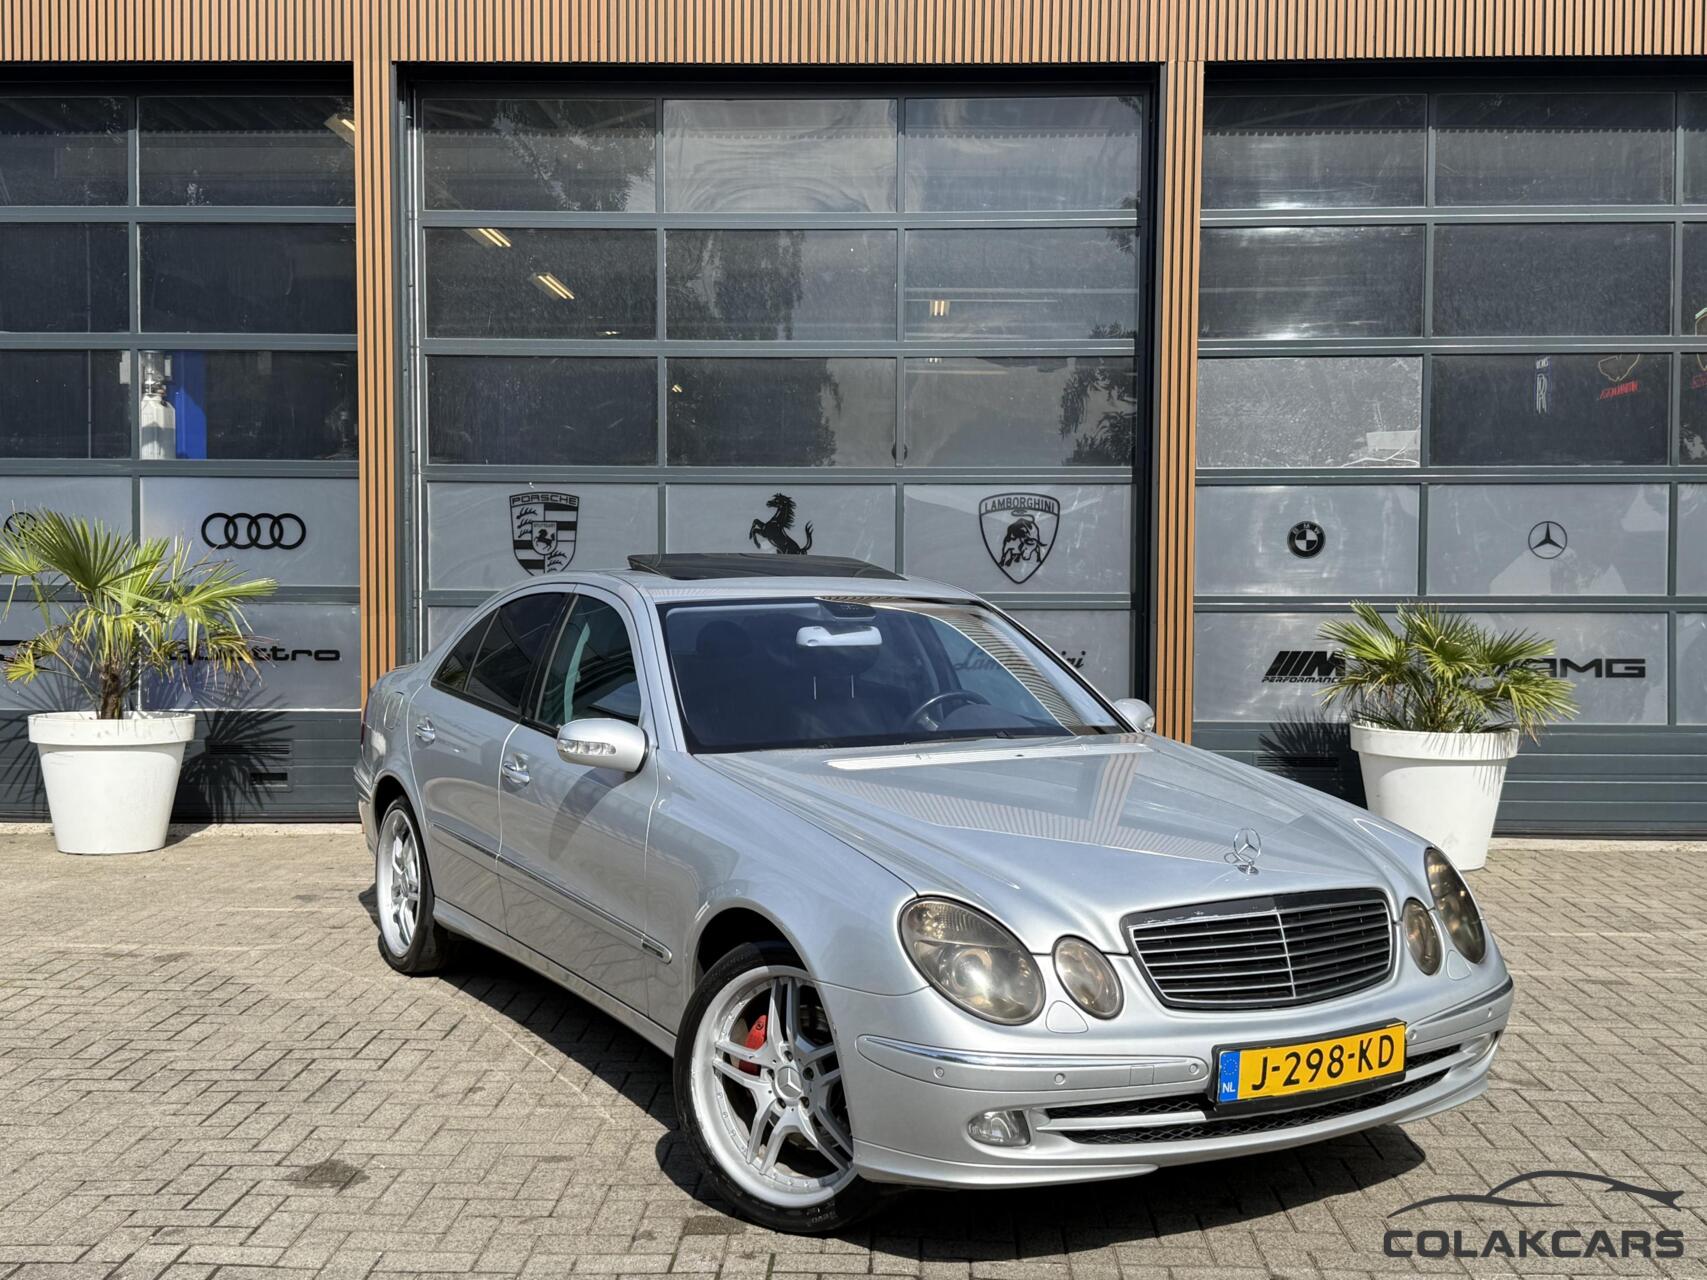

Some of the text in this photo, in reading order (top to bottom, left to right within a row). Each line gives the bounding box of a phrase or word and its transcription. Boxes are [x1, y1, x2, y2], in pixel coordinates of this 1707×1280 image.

[511, 494, 577, 506] PORSCHE
[984, 496, 1055, 513] LAMBORGHINI
[1251, 1034, 1395, 1091] J-298-KD
[1222, 1081, 1236, 1093] NL
